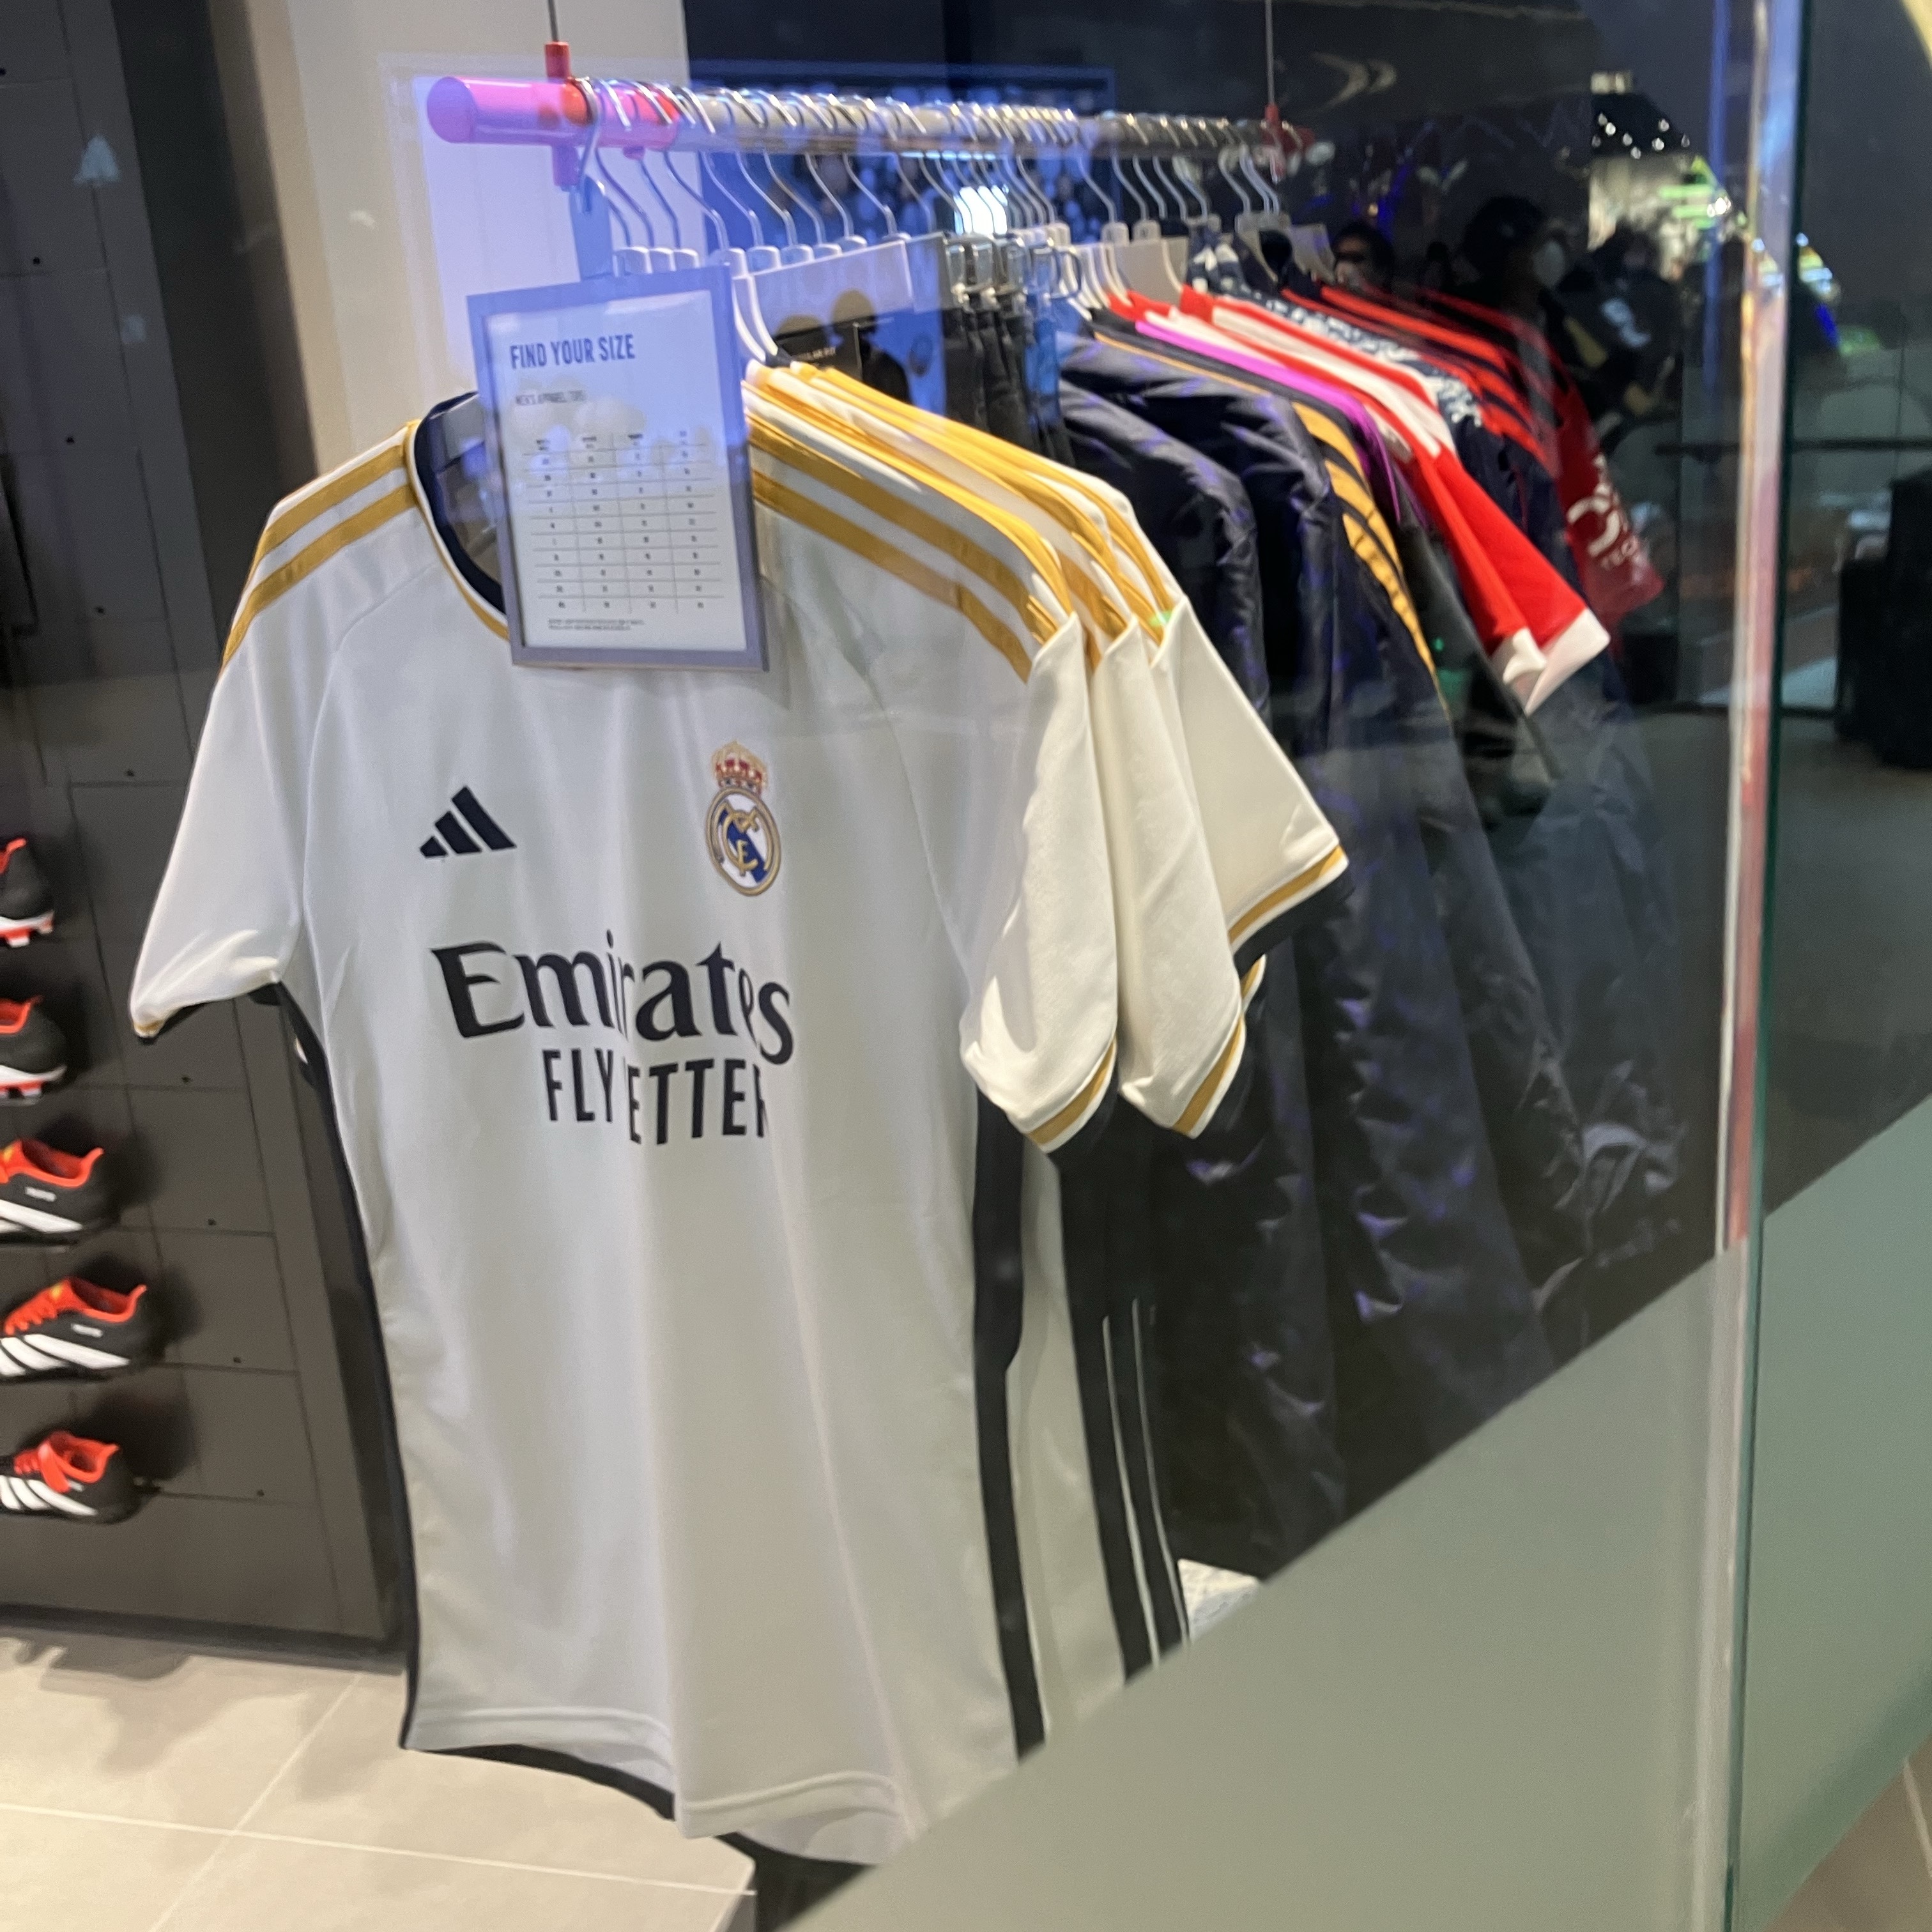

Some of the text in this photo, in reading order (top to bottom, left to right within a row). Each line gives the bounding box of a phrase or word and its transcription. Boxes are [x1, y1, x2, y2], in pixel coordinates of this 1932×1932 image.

[510, 333, 636, 370] FIND YOUR SIZE
[431, 929, 794, 1066] Emirates
[542, 1048, 770, 1146] FLY ETTE
